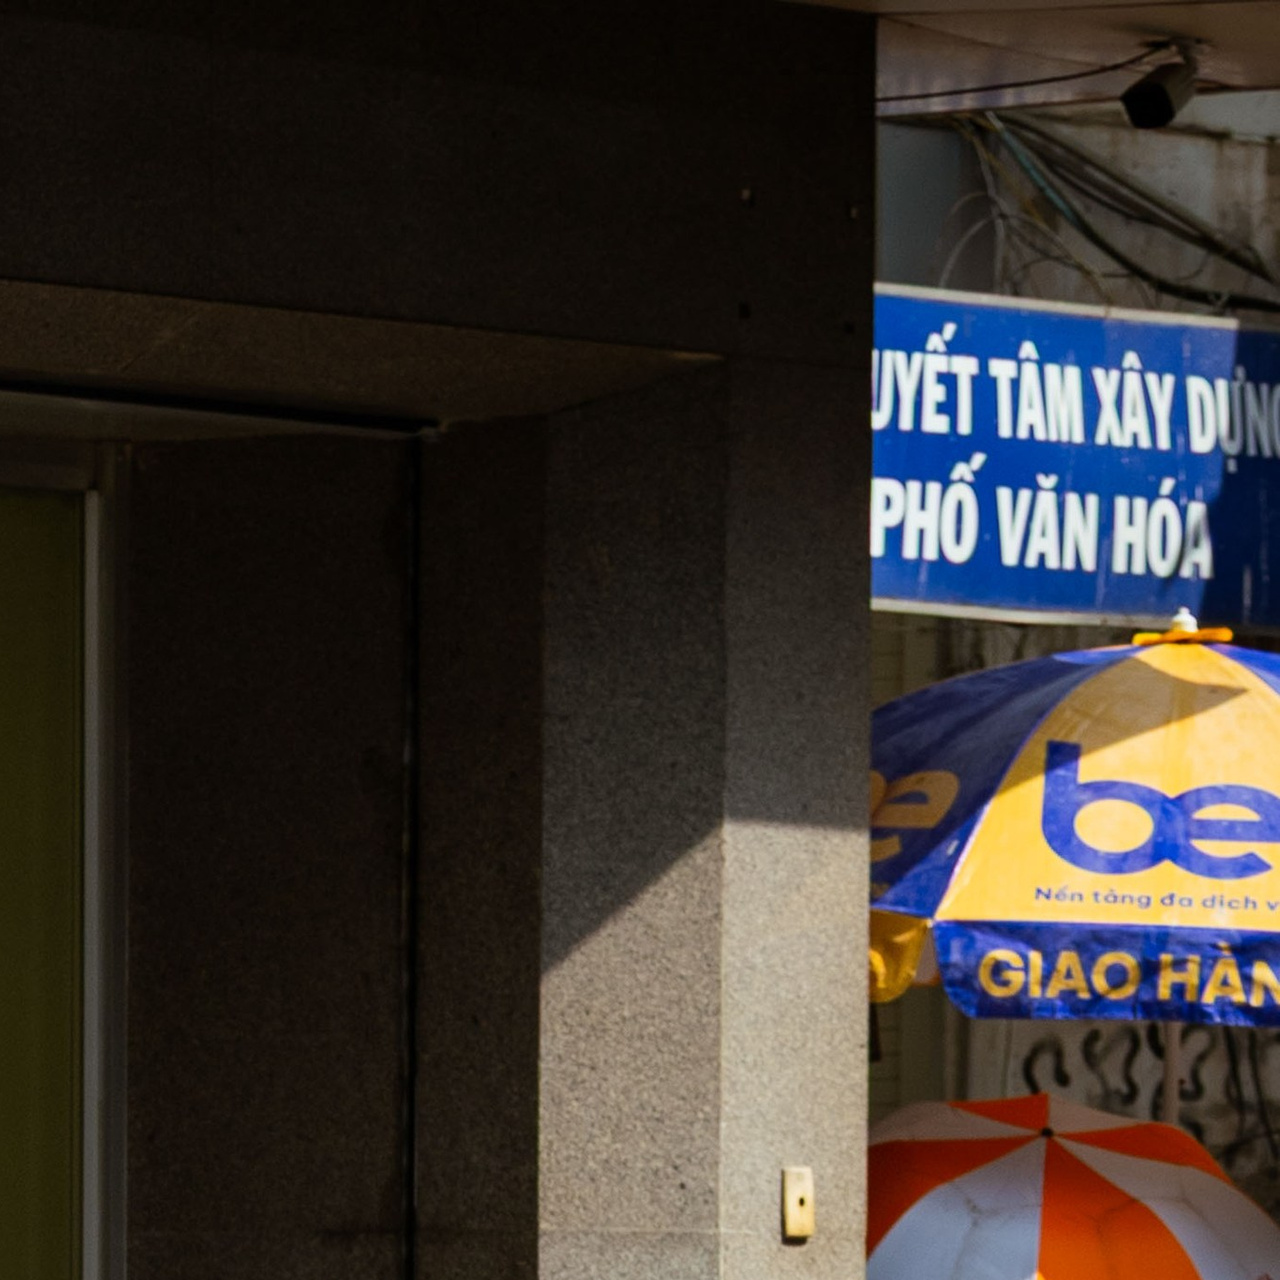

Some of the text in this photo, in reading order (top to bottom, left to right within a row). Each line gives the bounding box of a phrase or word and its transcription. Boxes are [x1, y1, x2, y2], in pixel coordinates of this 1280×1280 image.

[988, 340, 1085, 444] TÂM
[1092, 350, 1176, 451] XÂY
[1186, 366, 1280, 474] DỰN
[870, 452, 1214, 579] PHỐ VĂN HÓA
[1041, 740, 1280, 881] be
[978, 949, 1142, 1000] GIAO
